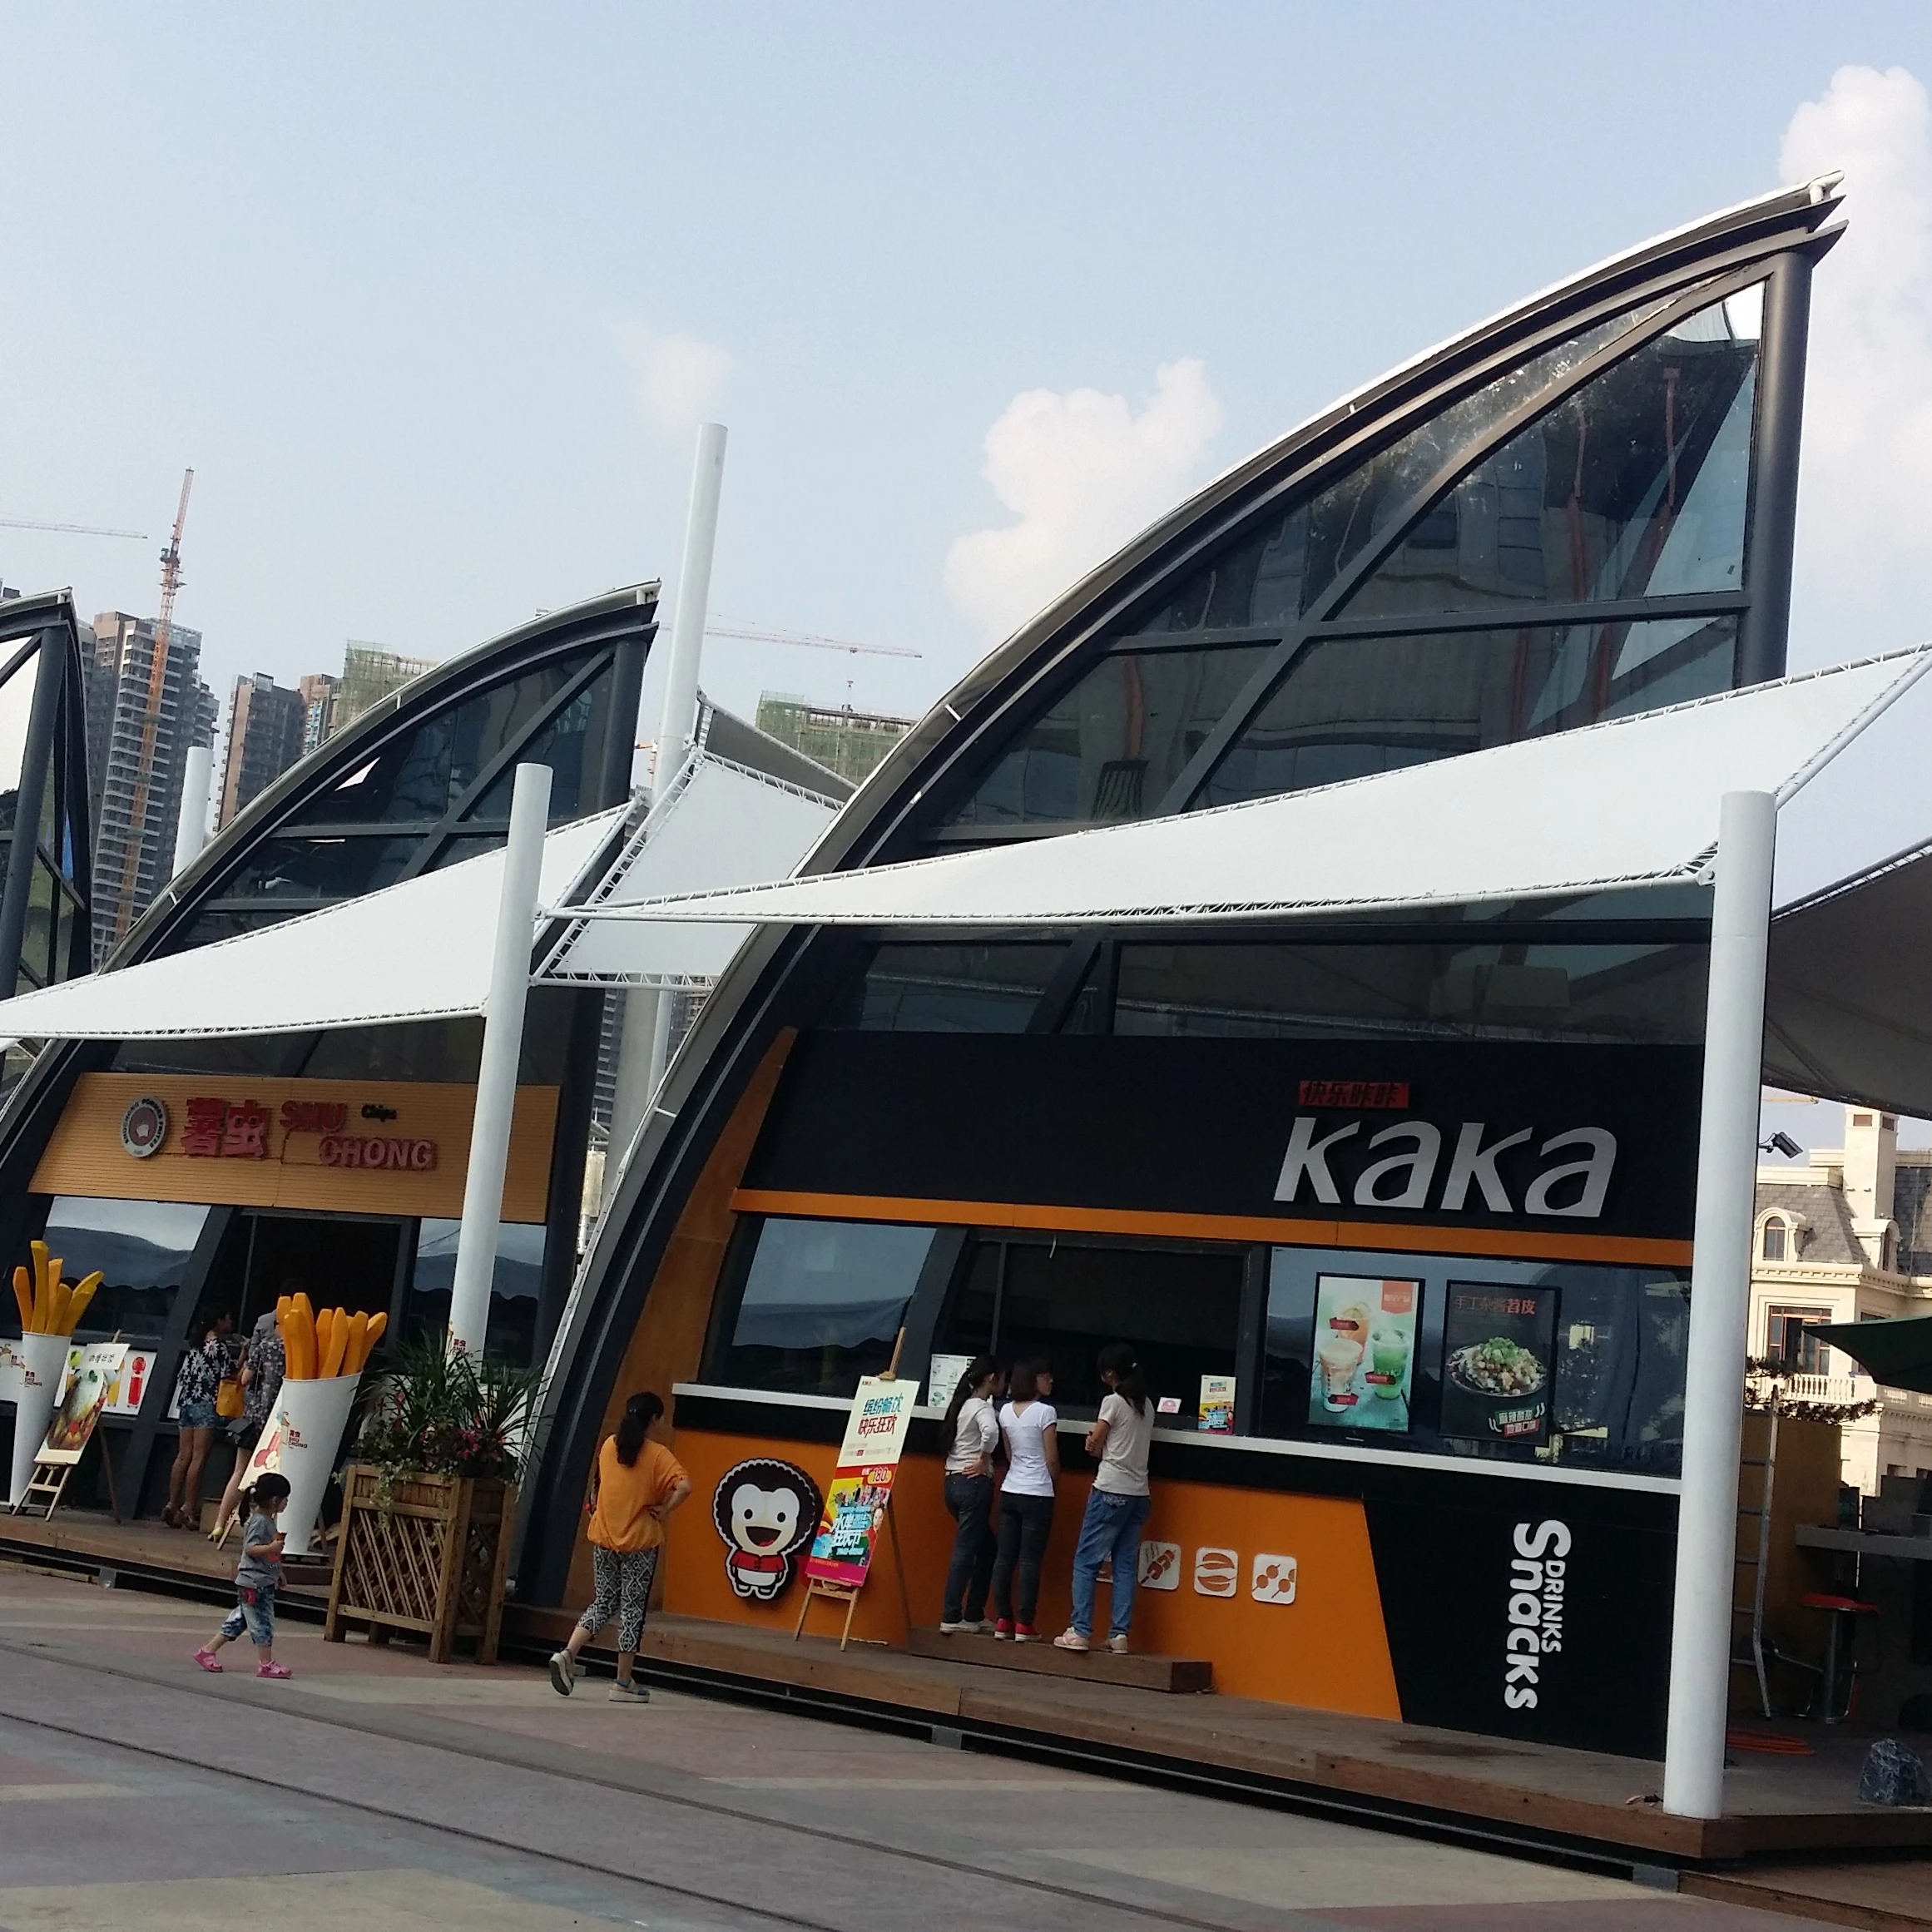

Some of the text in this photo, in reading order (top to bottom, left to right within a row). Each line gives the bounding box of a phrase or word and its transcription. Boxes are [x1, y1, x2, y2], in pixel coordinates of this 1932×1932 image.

[280, 1100, 346, 1132] SHU
[319, 1135, 436, 1170] CHONG
[857, 1413, 897, 1438] 快乐狂欢
[1504, 1519, 1572, 1709] Snacks
[1541, 1559, 1566, 1653] DRINKS
